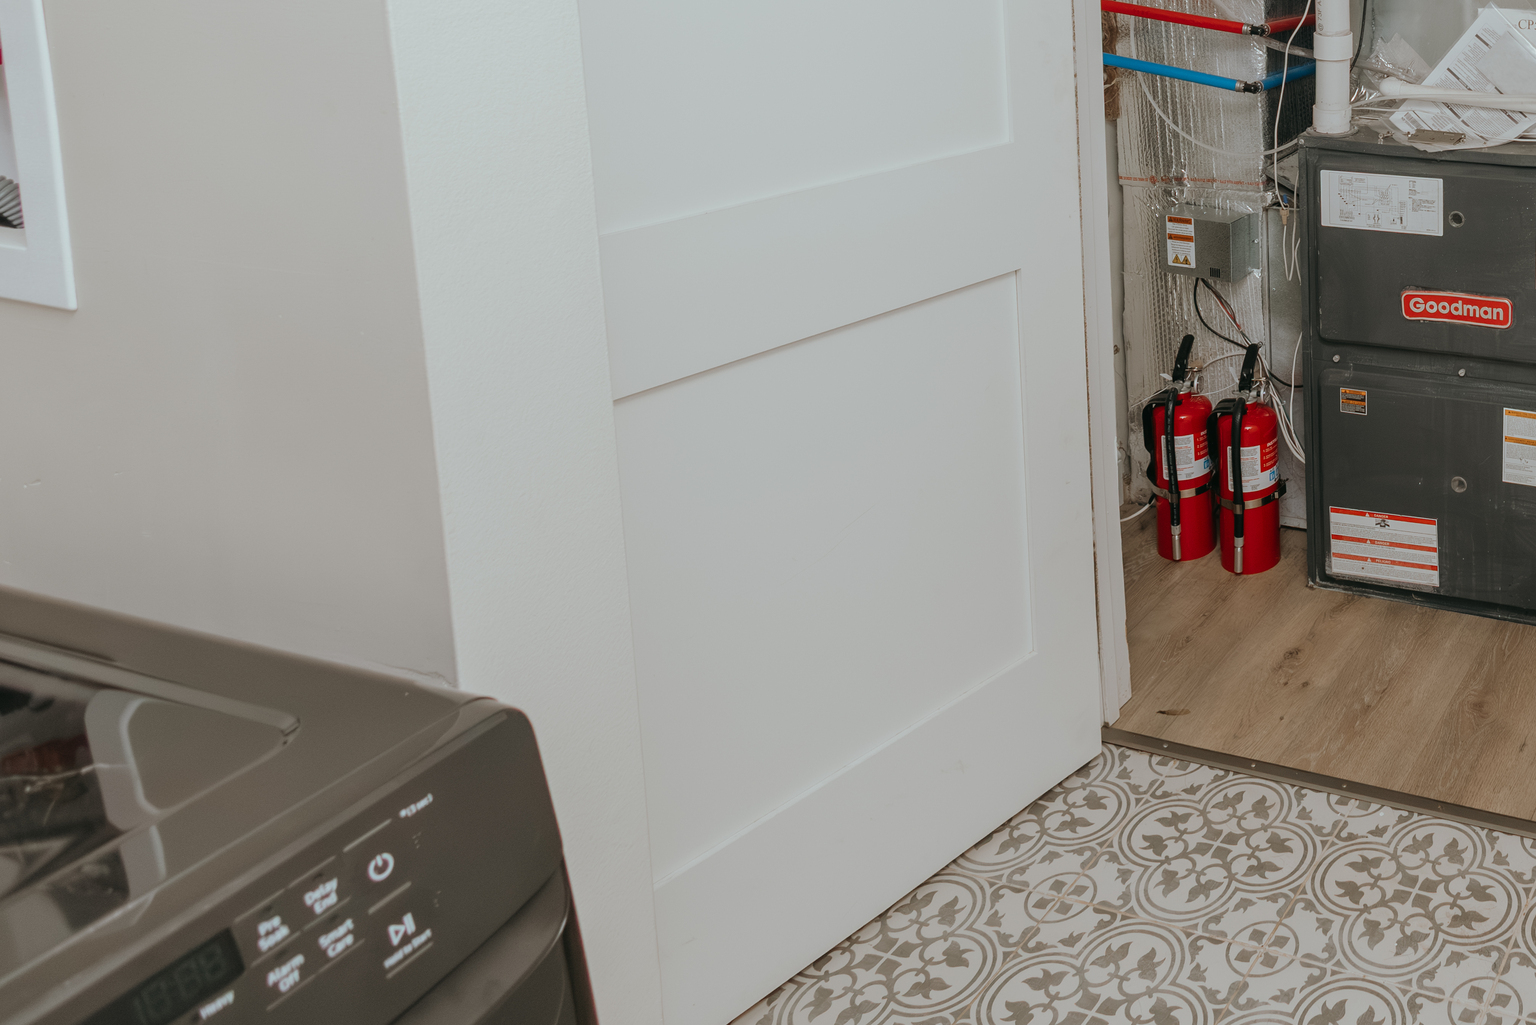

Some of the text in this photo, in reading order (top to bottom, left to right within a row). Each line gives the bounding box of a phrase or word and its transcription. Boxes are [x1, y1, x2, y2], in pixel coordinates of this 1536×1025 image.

[1409, 297, 1504, 321] Goodman
[304, 877, 338, 906] Delay
[313, 892, 338, 915] End
[258, 915, 281, 936] Pre
[318, 919, 354, 950] Smart
[258, 925, 290, 952] Soak
[327, 934, 354, 958] Care
[267, 954, 304, 987] Alarm
[278, 969, 300, 992] Off
